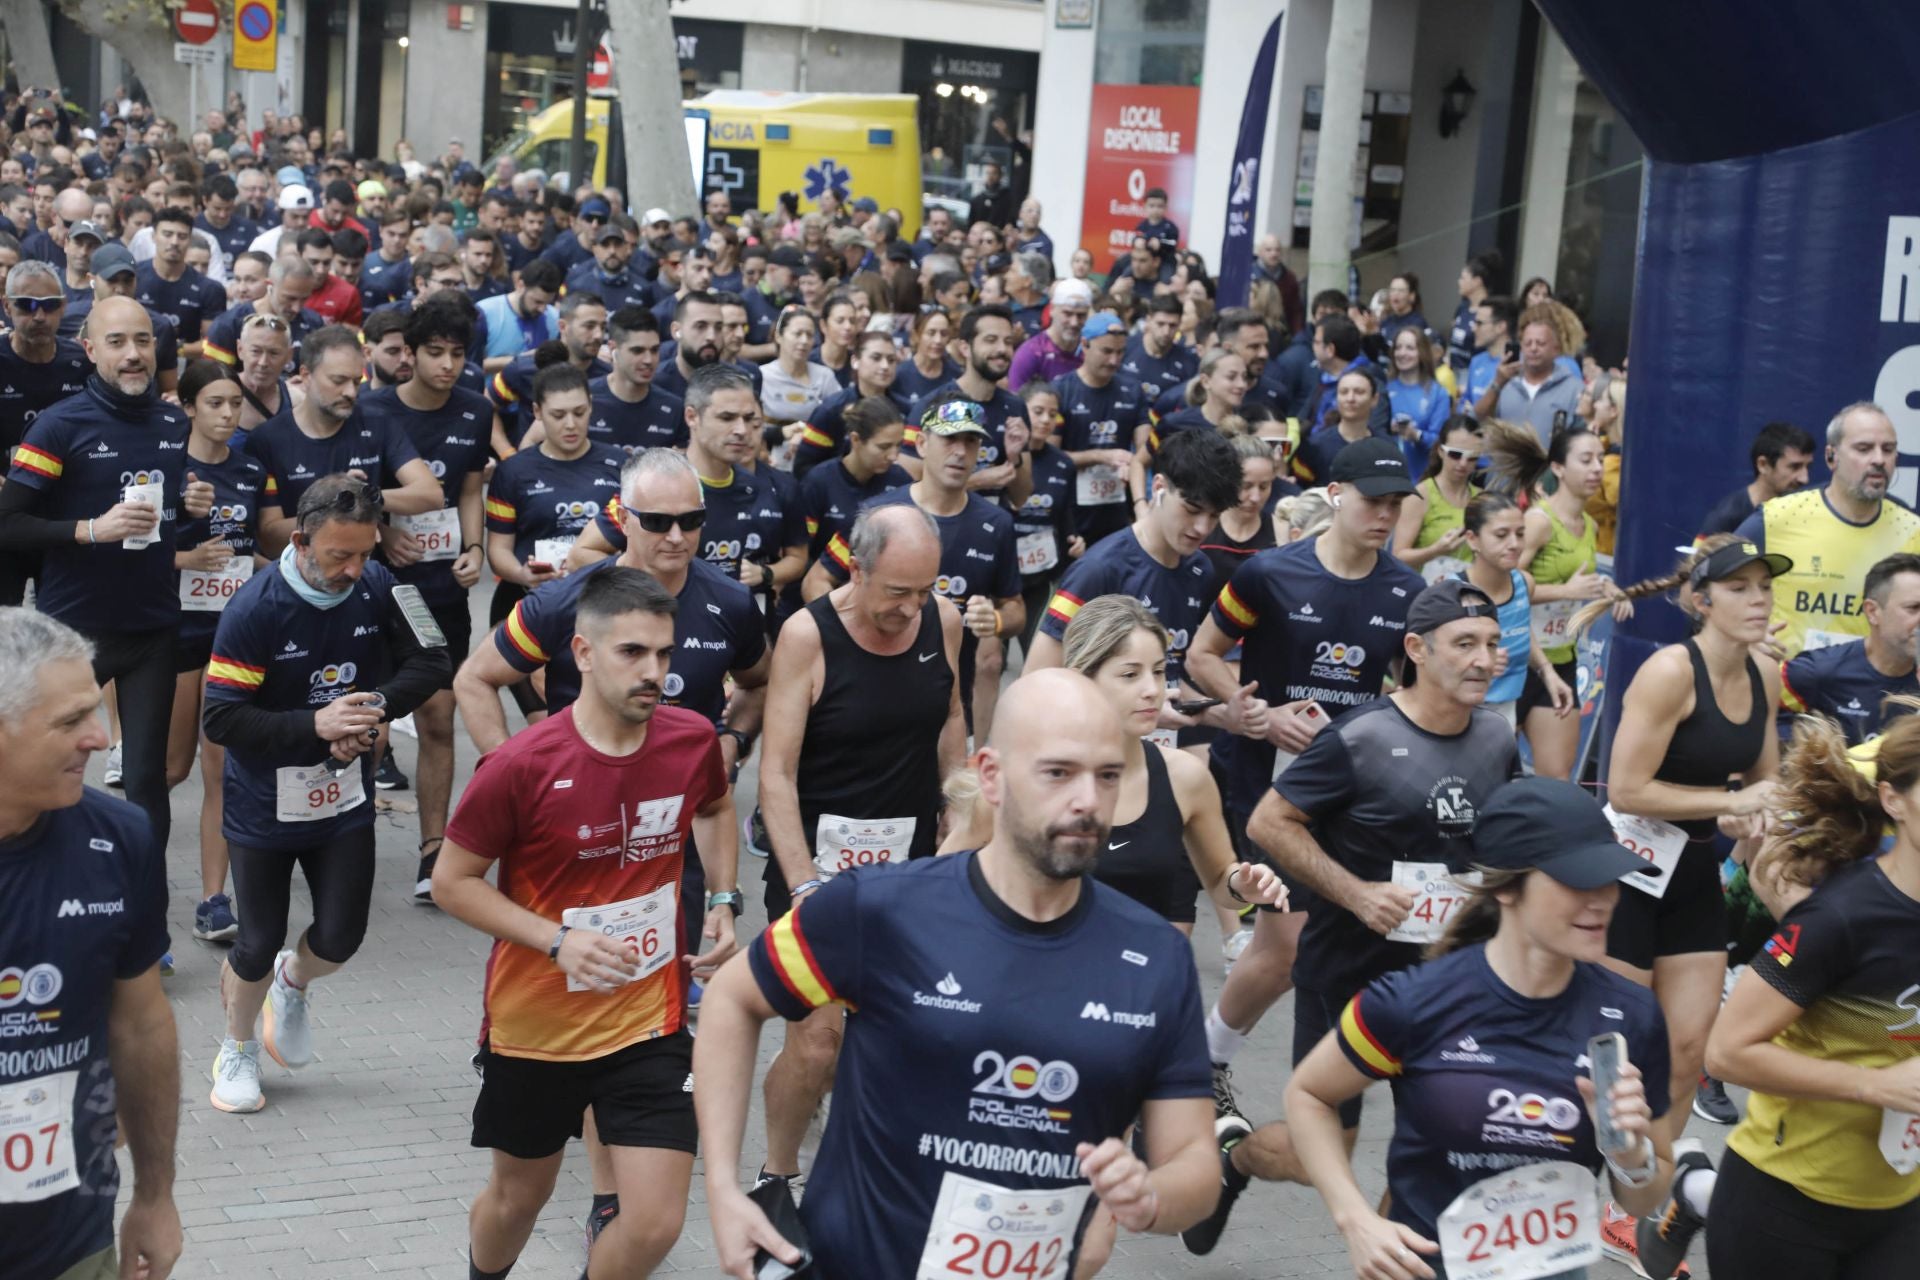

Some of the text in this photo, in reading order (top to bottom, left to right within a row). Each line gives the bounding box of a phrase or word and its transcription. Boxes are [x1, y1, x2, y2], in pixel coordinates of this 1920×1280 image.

[1120, 106, 1162, 129] LOCAL
[1104, 128, 1180, 153] DISPONIBLE
[88, 452, 119, 460] Santander
[209, 504, 248, 524] 200
[555, 501, 600, 519] 200
[705, 540, 741, 560] 200
[1289, 612, 1322, 623] Santander
[275, 649, 309, 660] Santander
[703, 640, 727, 651] mupol
[1314, 641, 1366, 667] 200
[310, 662, 357, 692] 200
[308, 782, 341, 808] 98
[88, 898, 124, 916] mupol
[913, 991, 982, 1013] Santander
[0, 1012, 39, 1025] ICIA
[1113, 1011, 1156, 1029] mupol
[972, 1050, 1079, 1102] 200
[969, 1098, 1050, 1118] POLICIA
[1486, 1088, 1580, 1131] 200
[968, 1111, 1070, 1134] NACIONAL
[1463, 1200, 1579, 1262] 2405
[1604, 1226, 1617, 1241] new
[946, 1233, 1062, 1280] 2042
